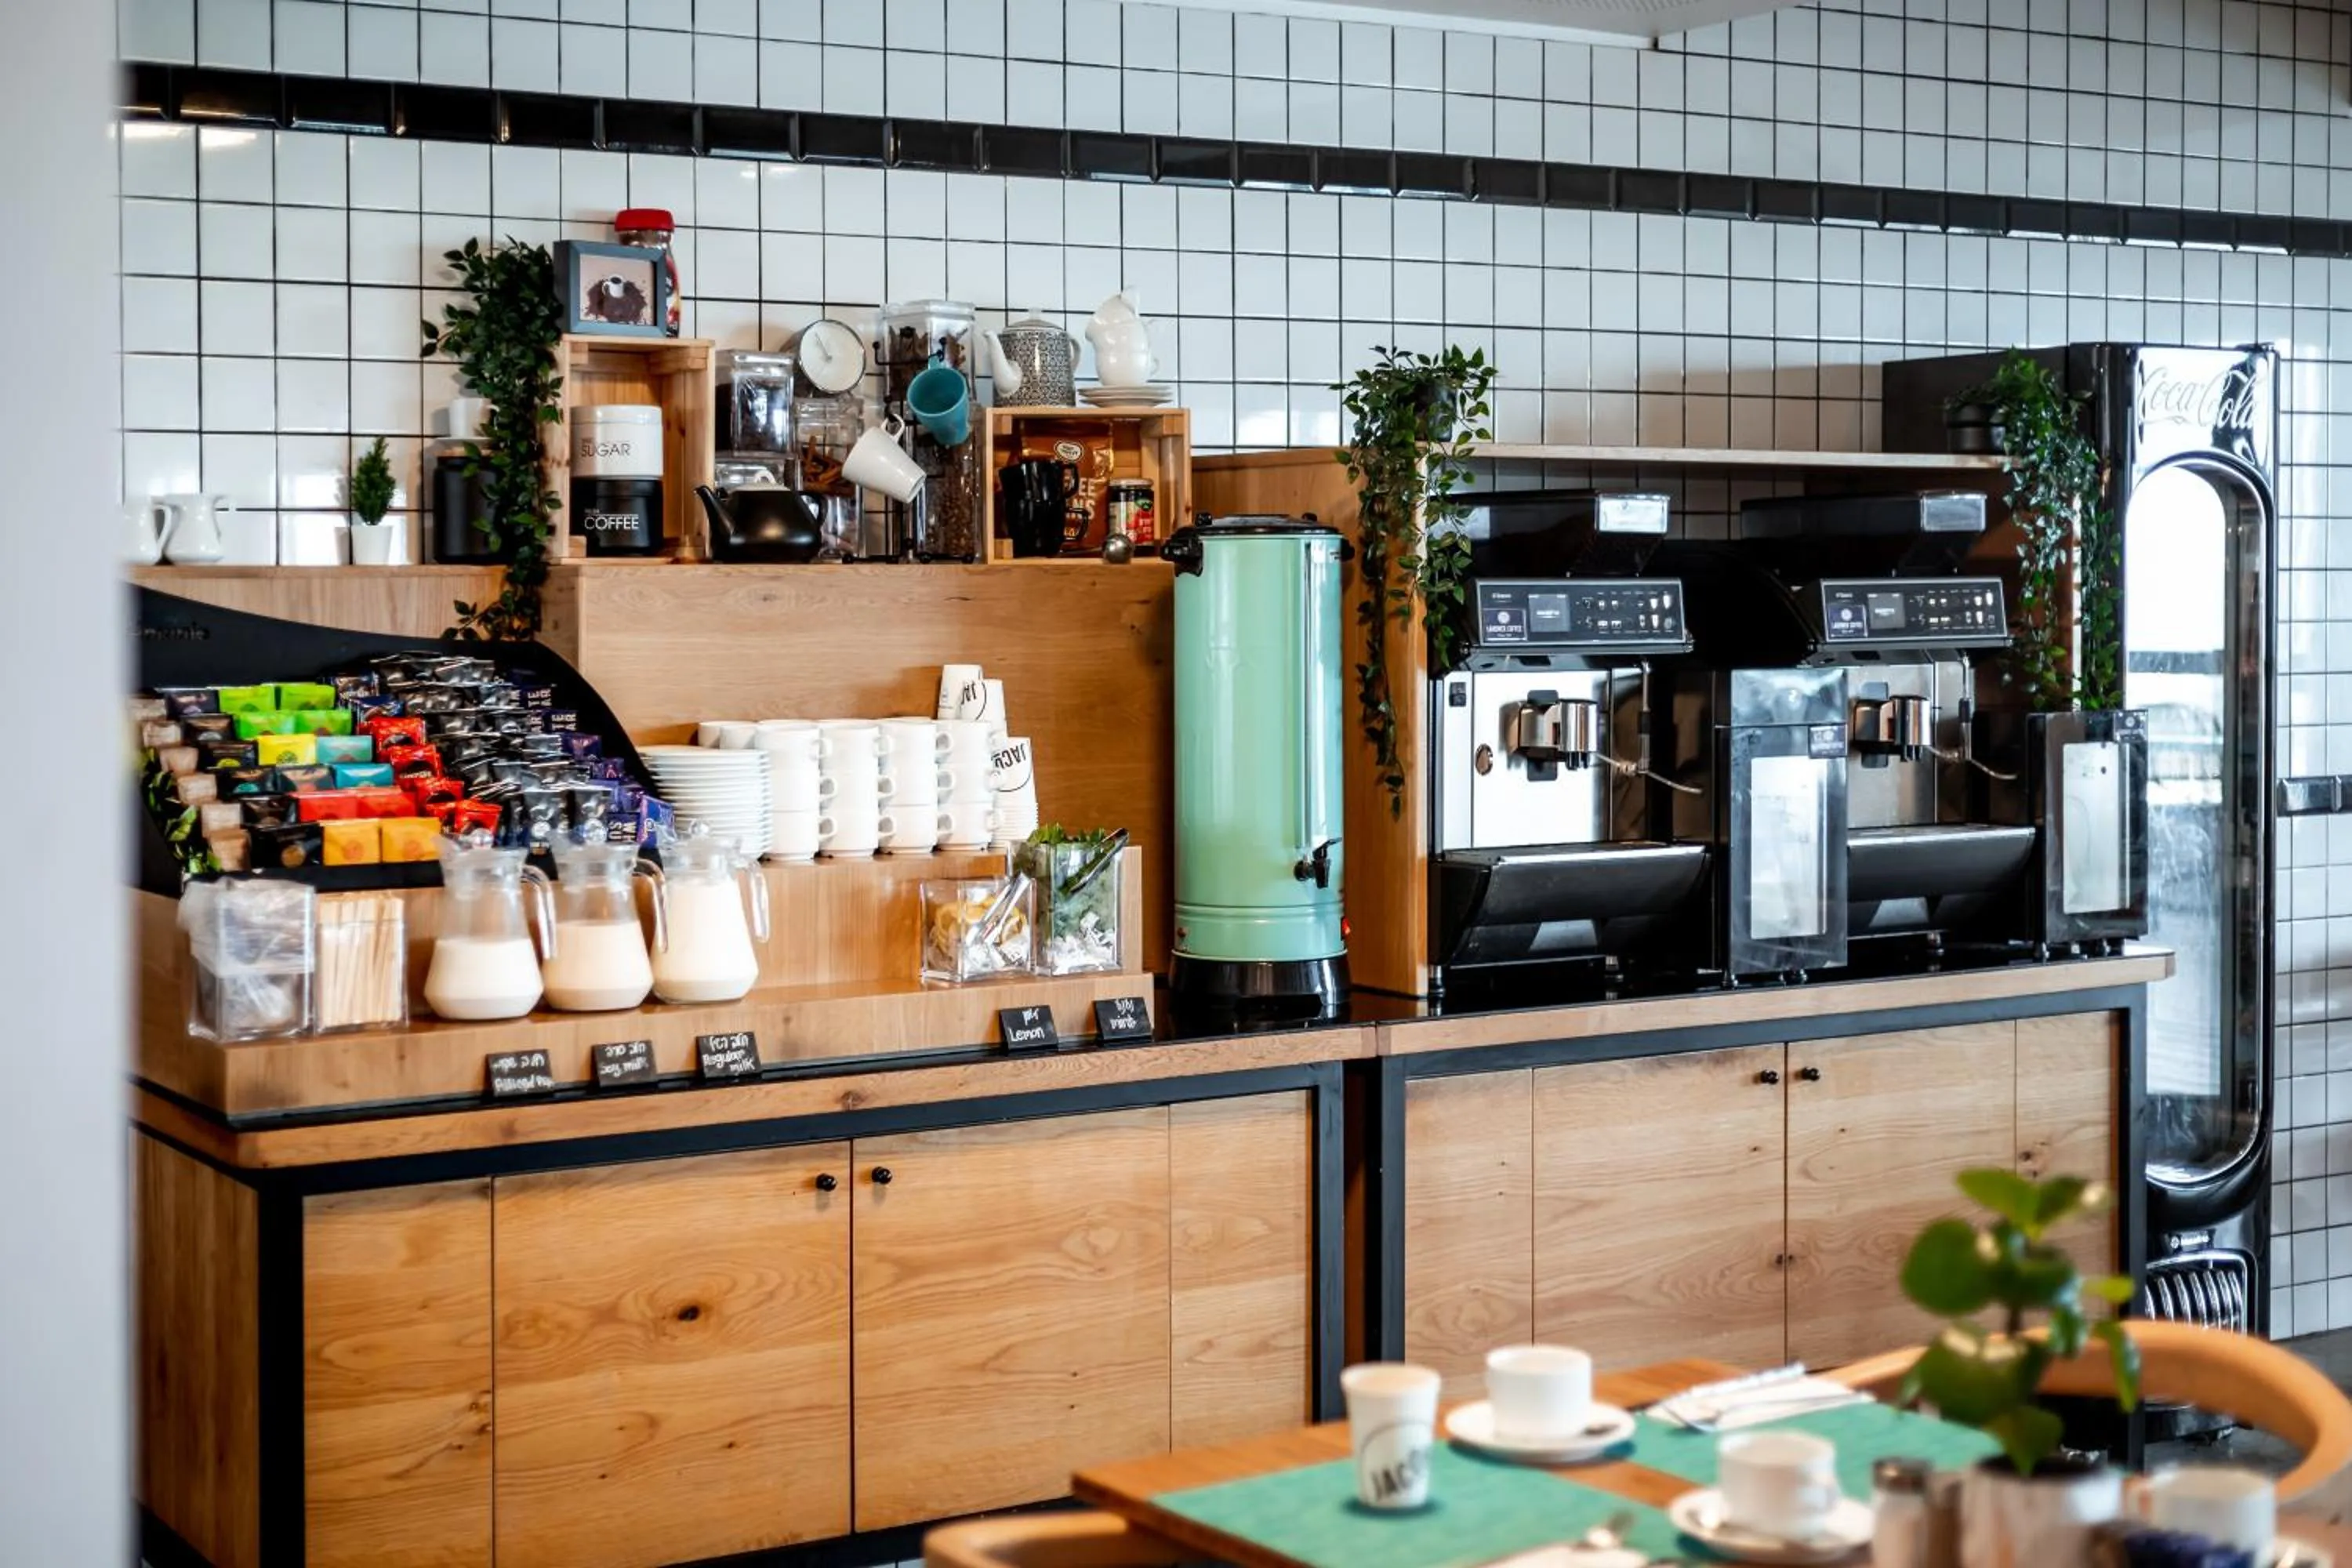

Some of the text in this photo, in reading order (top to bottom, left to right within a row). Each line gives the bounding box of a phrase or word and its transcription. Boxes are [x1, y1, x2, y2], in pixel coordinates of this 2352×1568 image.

[580, 442, 631, 457] SUGAR
[584, 516, 640, 530] COFFEE
[1008, 1026, 1045, 1042] Lemon
